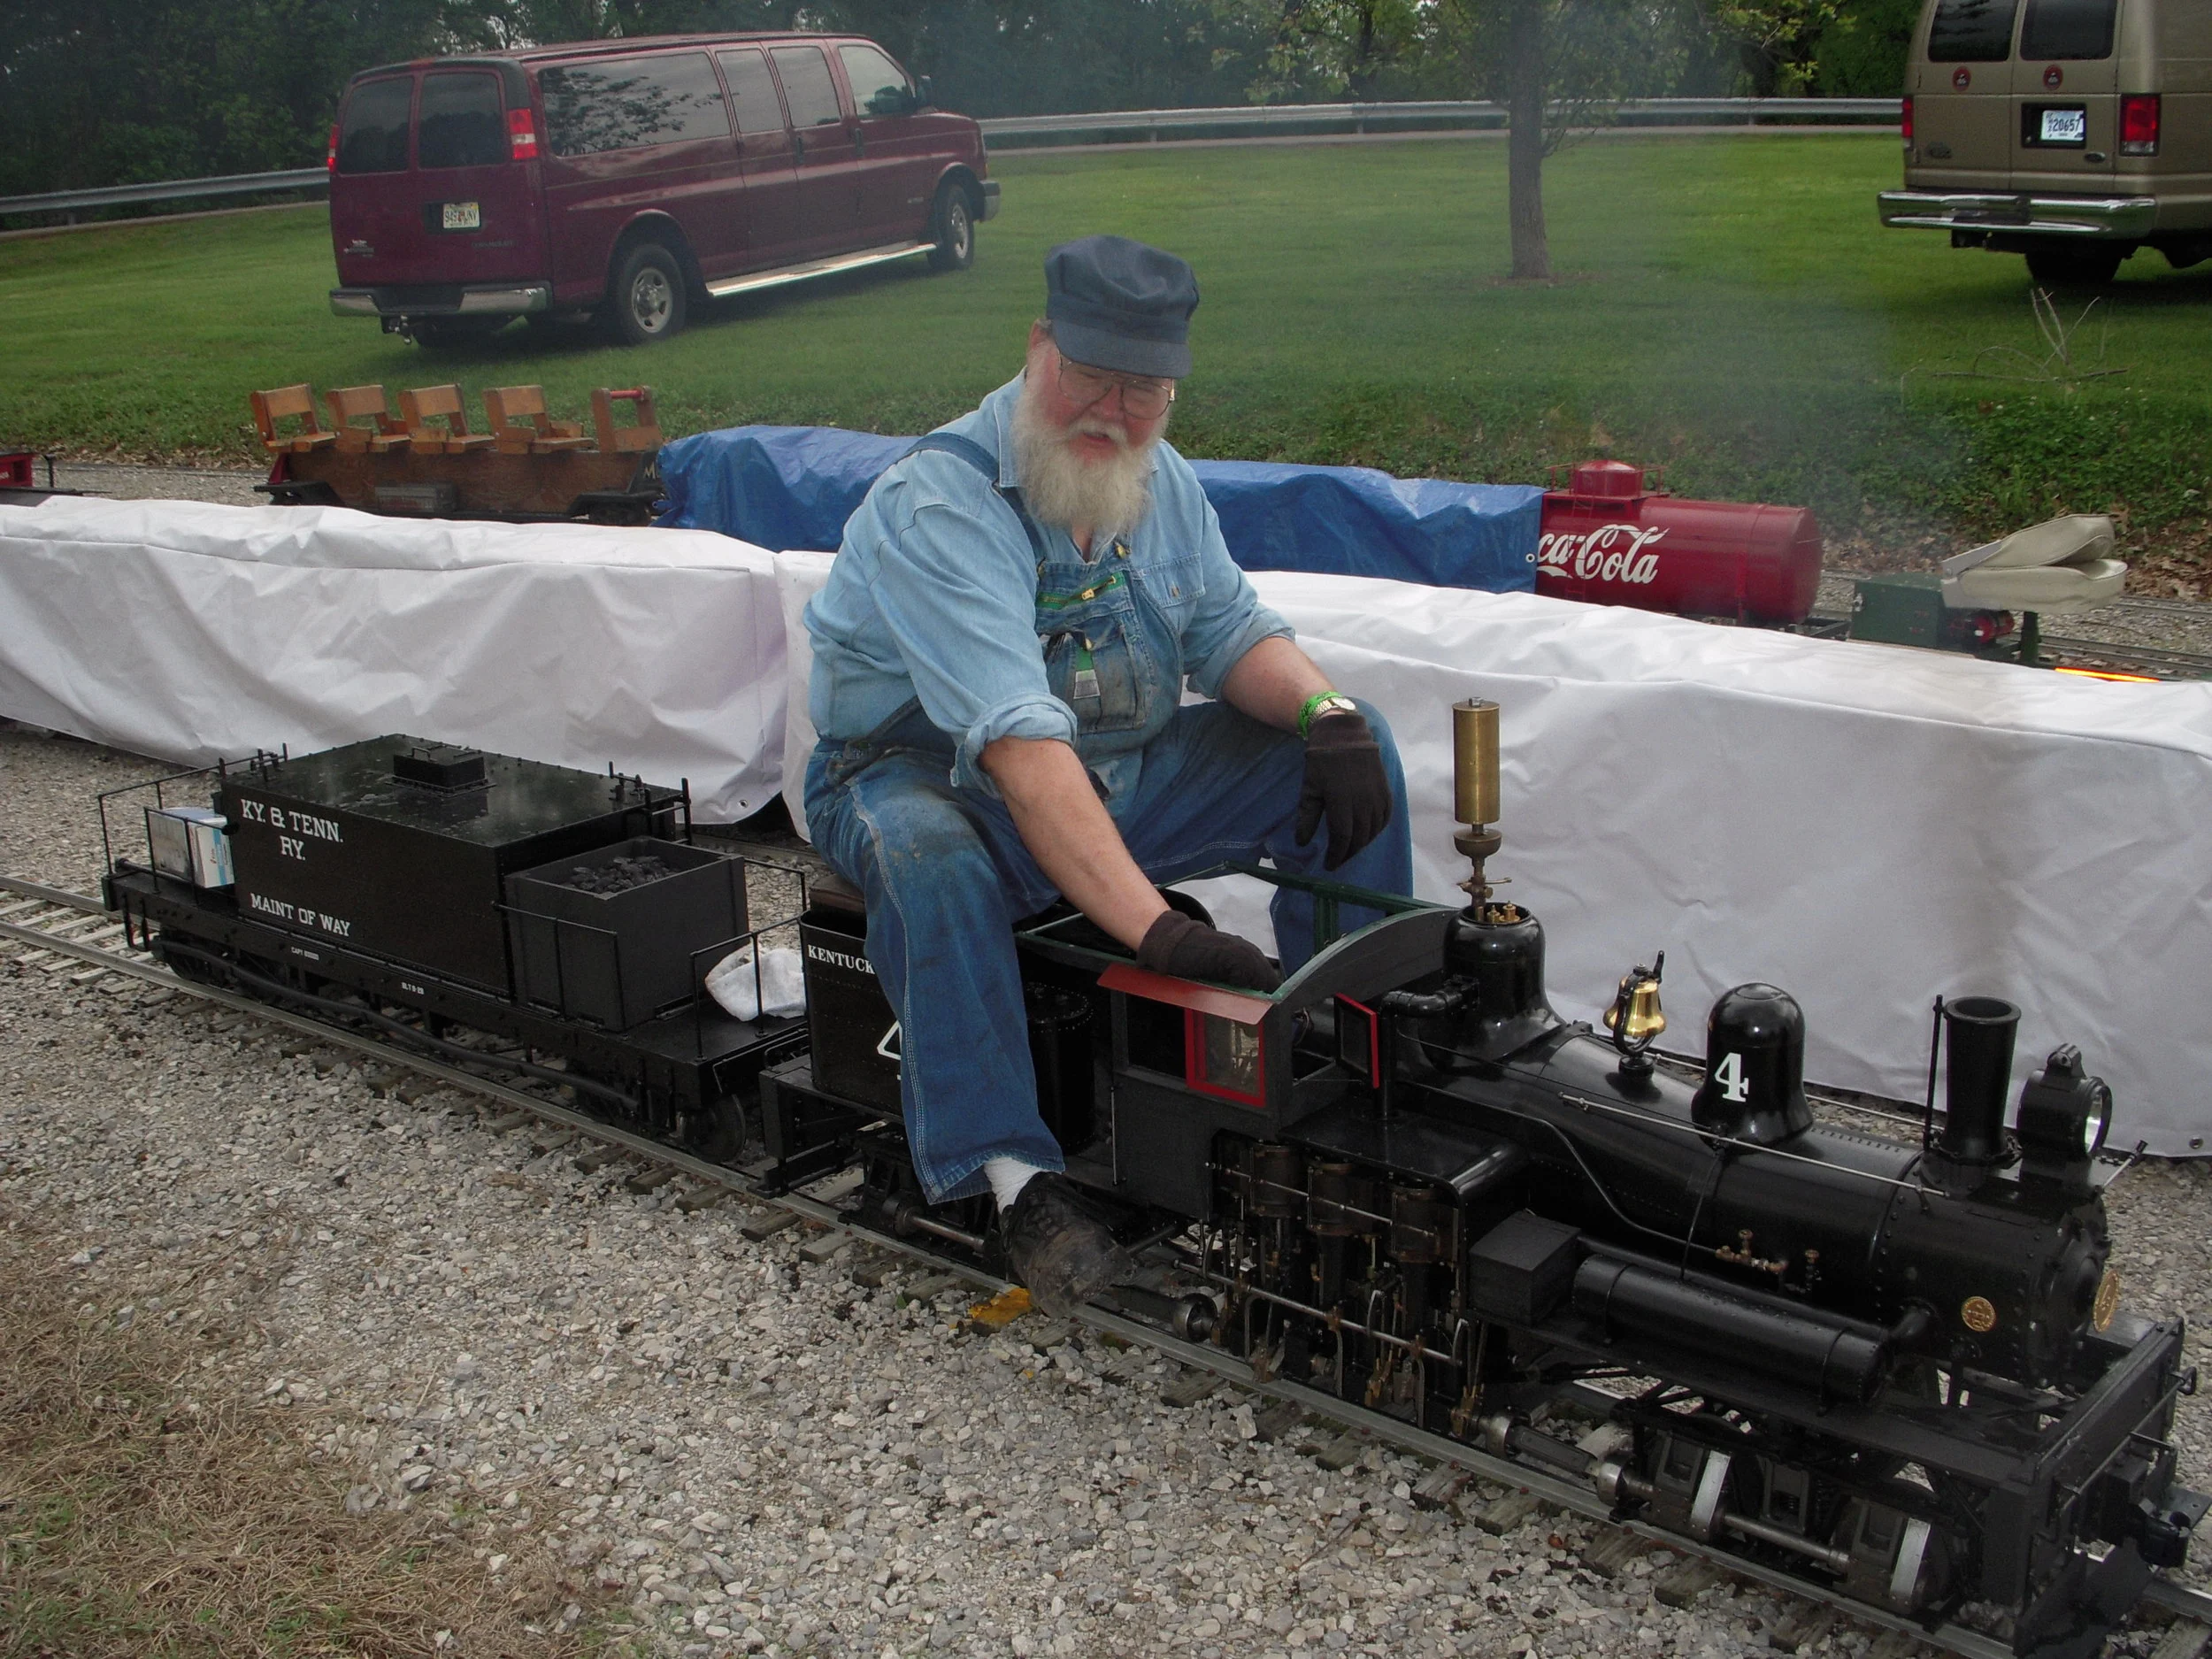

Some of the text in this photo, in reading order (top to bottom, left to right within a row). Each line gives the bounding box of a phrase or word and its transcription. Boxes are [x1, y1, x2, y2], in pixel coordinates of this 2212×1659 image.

[270, 807, 286, 828] &
[288, 810, 343, 842] TENN.
[280, 835, 305, 860] RY.
[250, 893, 350, 936] MAINT OF WAY
[807, 944, 875, 974] KENTUCK
[1714, 1052, 1749, 1102] 4
